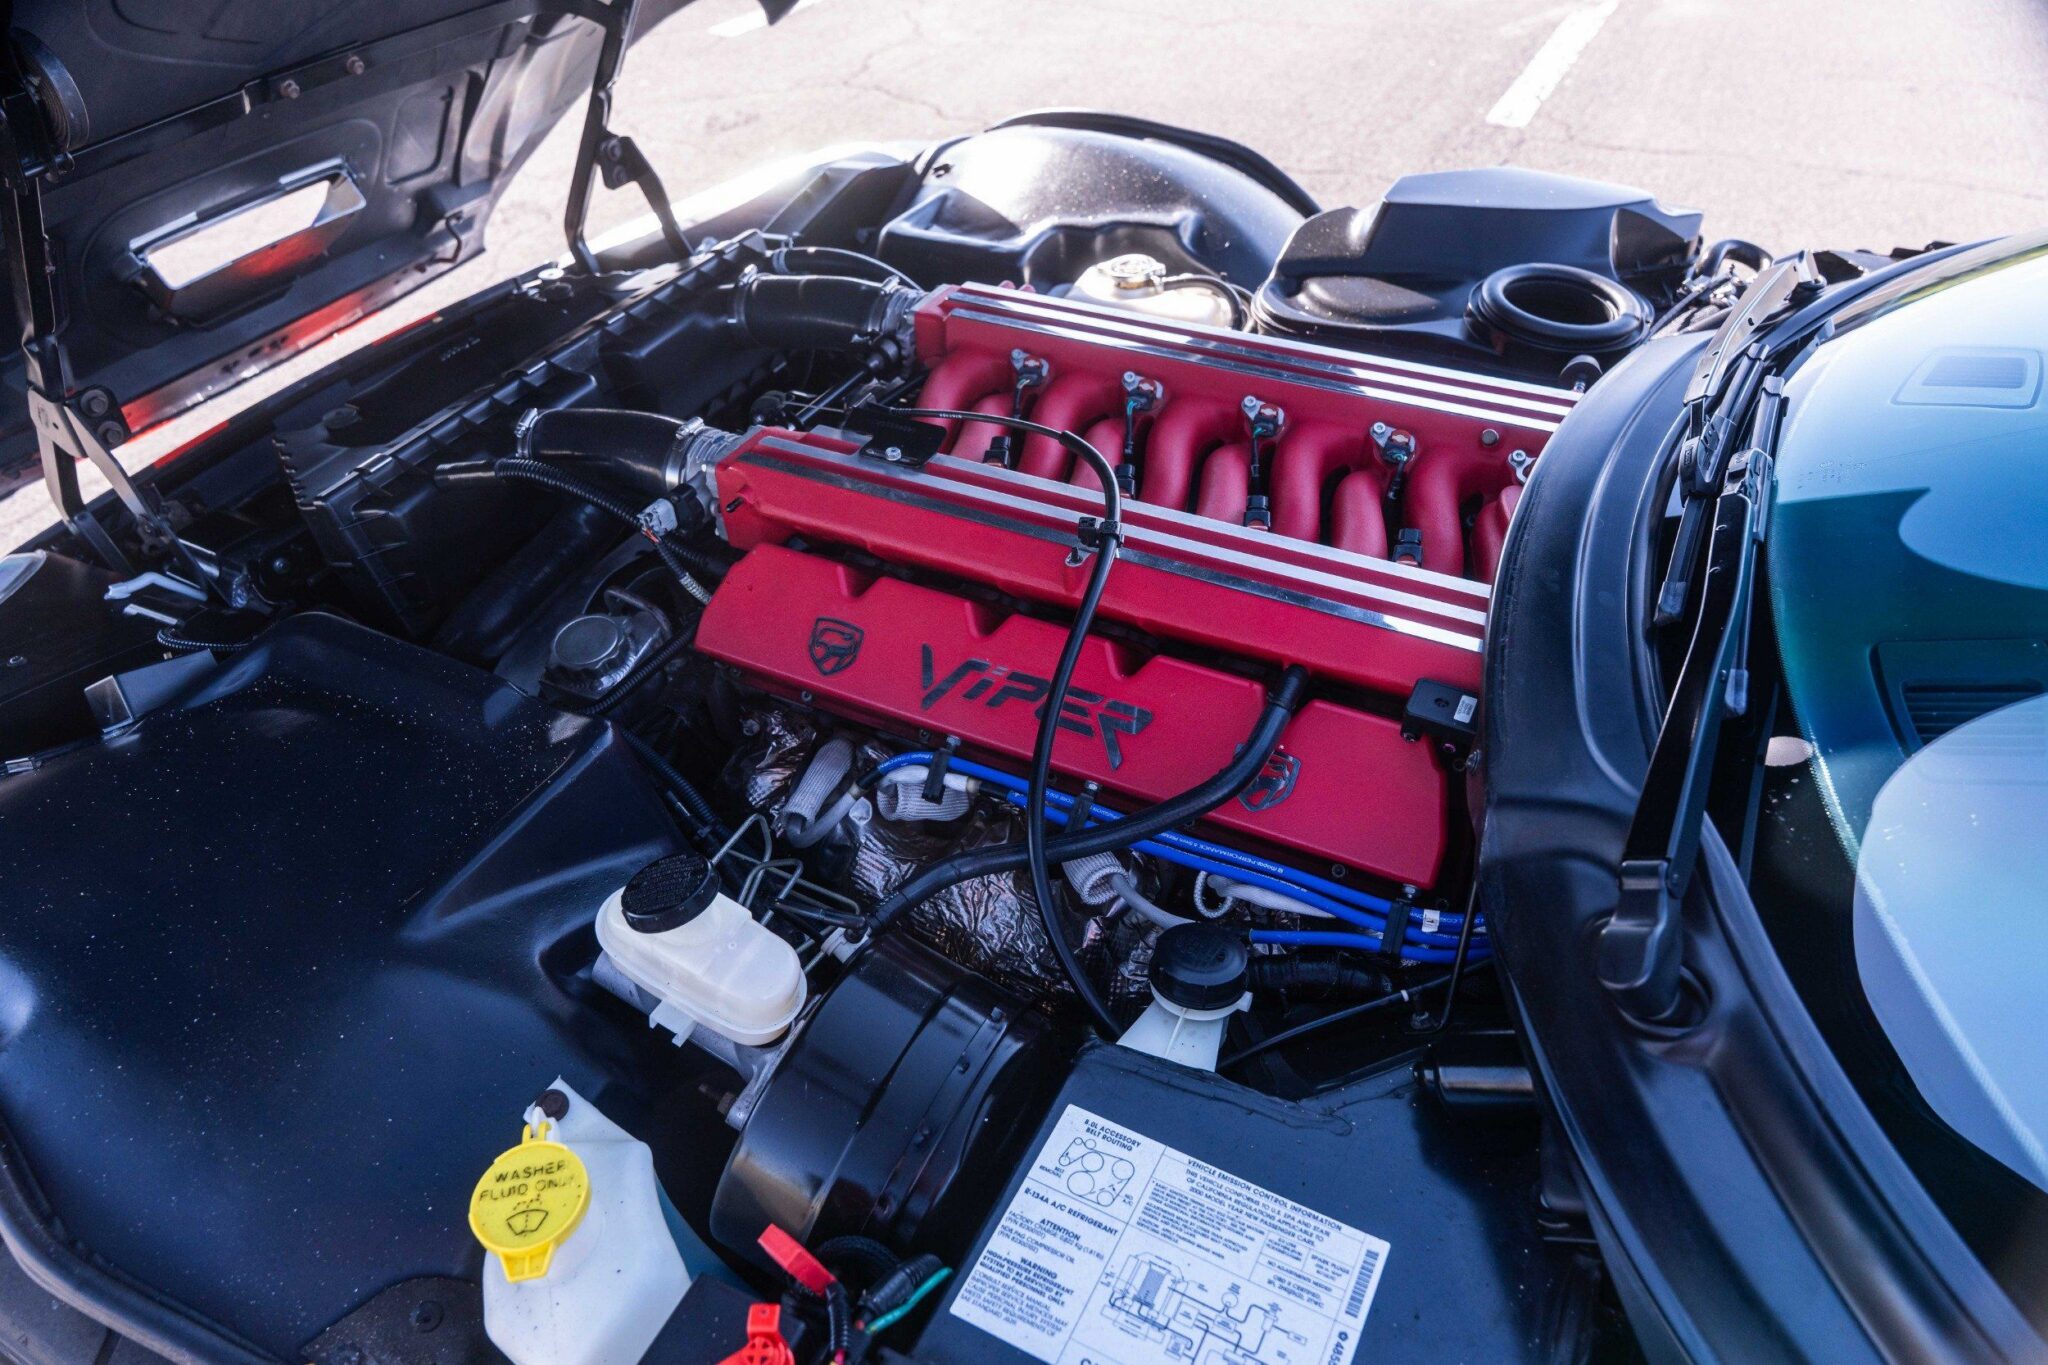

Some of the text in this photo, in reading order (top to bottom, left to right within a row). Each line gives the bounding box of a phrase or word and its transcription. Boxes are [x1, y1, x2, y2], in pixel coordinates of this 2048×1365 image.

[1084, 1126, 1133, 1152] BELT ROUTING
[1098, 1125, 1141, 1148] ACCESSORY
[480, 1183, 528, 1202] FLUID
[1186, 1158, 1343, 1231] VEHICLE EMISSION CONTROL INFORMATION
[1194, 1180, 1233, 1201] CALIFORNIA
[1233, 1198, 1276, 1220] REGULATIONS
[1197, 1173, 1224, 1189] VEHICLE
[1223, 1185, 1261, 1206] CONFORMS
[1203, 1192, 1227, 1206] MODEL
[1023, 1187, 1119, 1235] R-134A A/C REFRIGERANT
[1039, 1216, 1081, 1241] ATTENTION
[978, 1260, 1011, 1279] QUALIFIED
[1010, 1276, 1047, 1297] PERSONNEL
[981, 1254, 1005, 1269] SYSTEM
[1005, 1266, 1015, 1274] TO
[1023, 1274, 1054, 1293] SERVICED
[1053, 1289, 1063, 1297] BY
[1018, 1256, 1058, 1279] WARNING
[1031, 1271, 1074, 1295] REFRIGERANT
